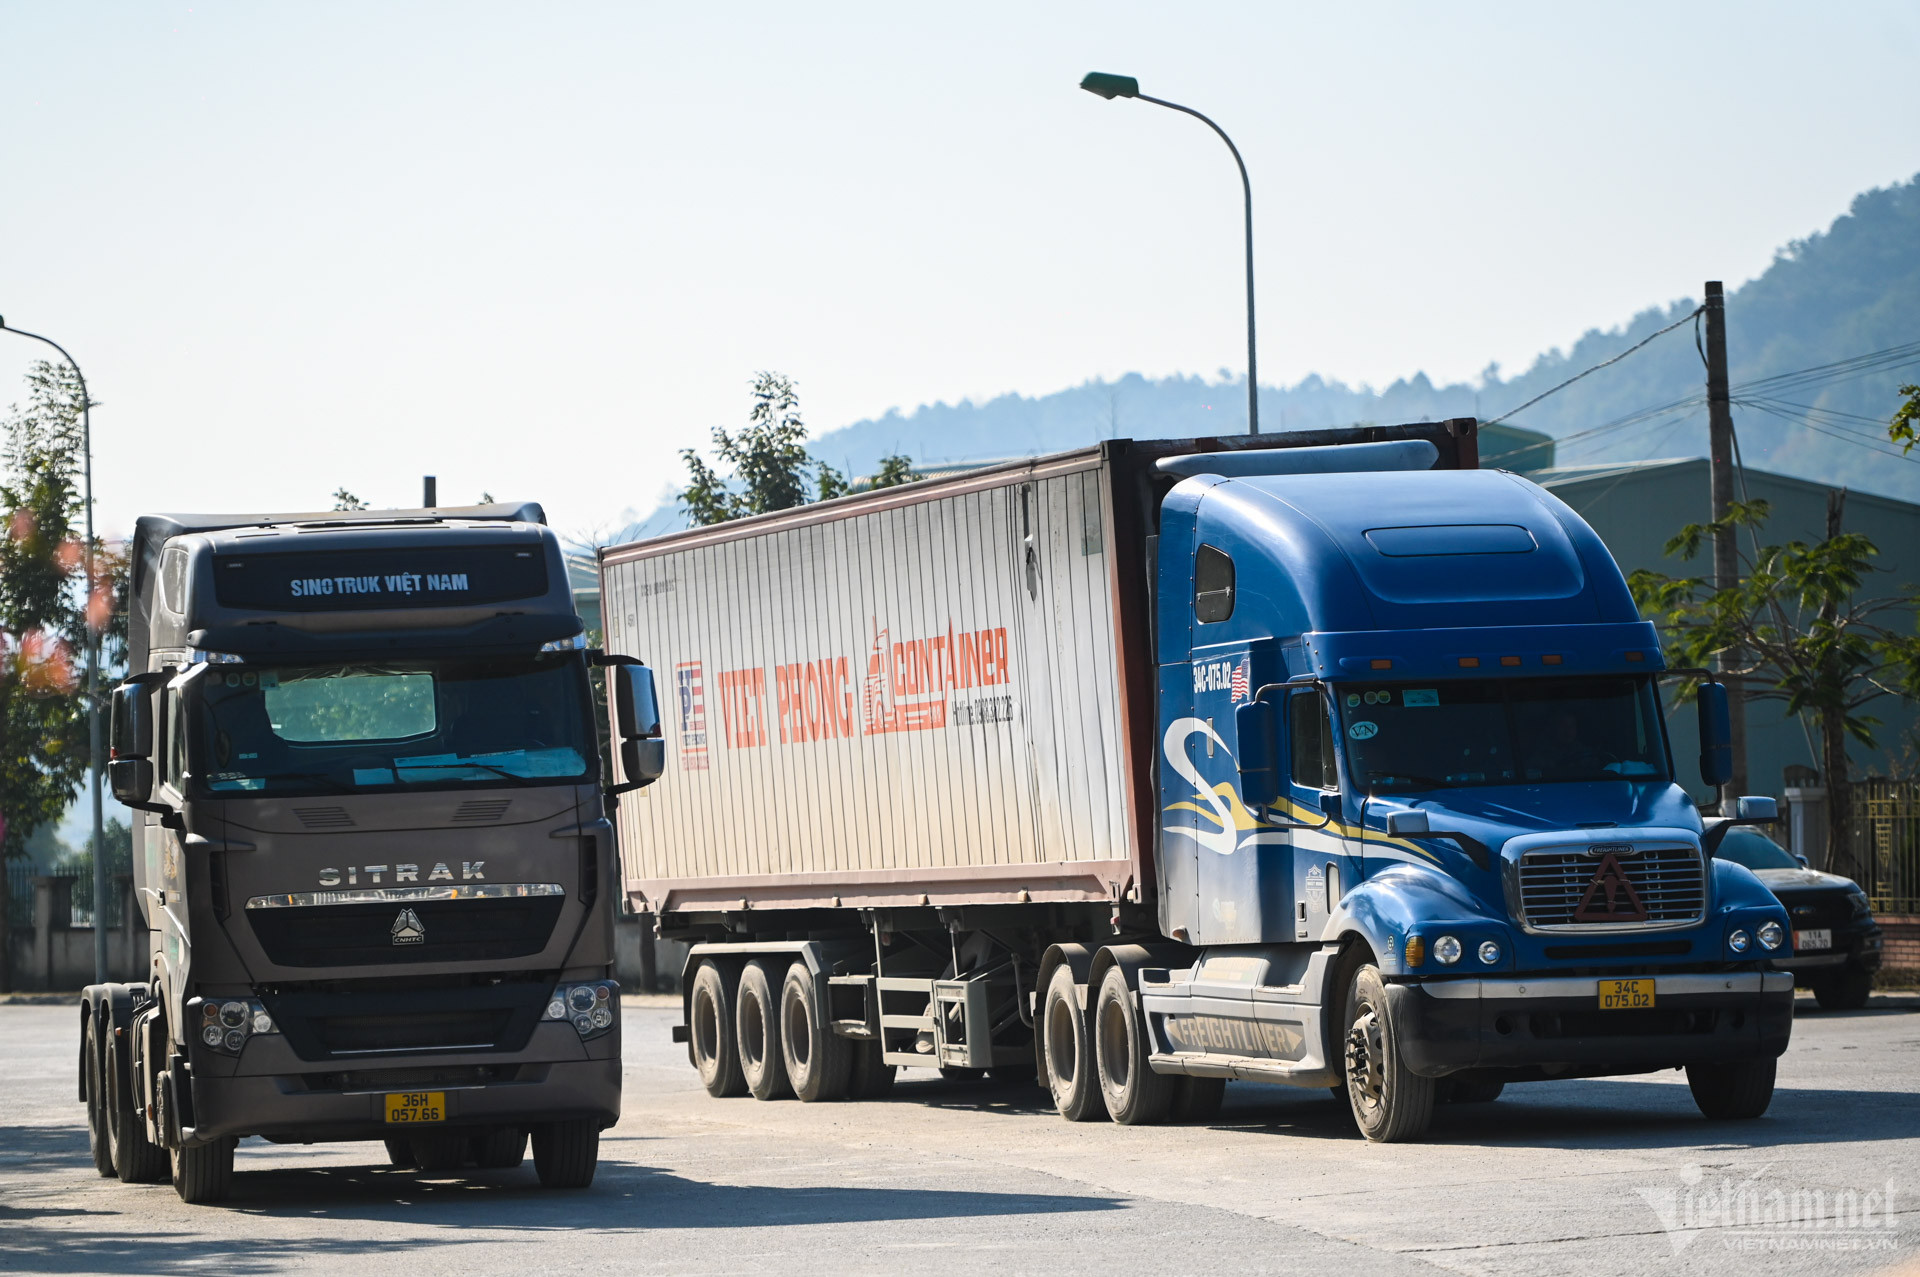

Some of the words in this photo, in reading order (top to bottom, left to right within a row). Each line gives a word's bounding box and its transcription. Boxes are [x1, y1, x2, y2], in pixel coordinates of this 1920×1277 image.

[384, 572, 421, 595] VIỆT
[427, 574, 469, 591] NAM
[893, 616, 1010, 697] CONTAINER
[1193, 661, 1232, 694] 34C-075.02
[717, 667, 766, 749] VIET
[775, 656, 854, 744] PHONG
[1352, 724, 1375, 738] VN
[318, 861, 485, 887] SITRAK
[1614, 981, 1639, 994] 34C
[1605, 994, 1649, 1007] 075.02
[1180, 1016, 1288, 1054] FREIGHTLINER
[402, 1094, 428, 1107] 36H
[392, 1107, 439, 1121] 057.66
